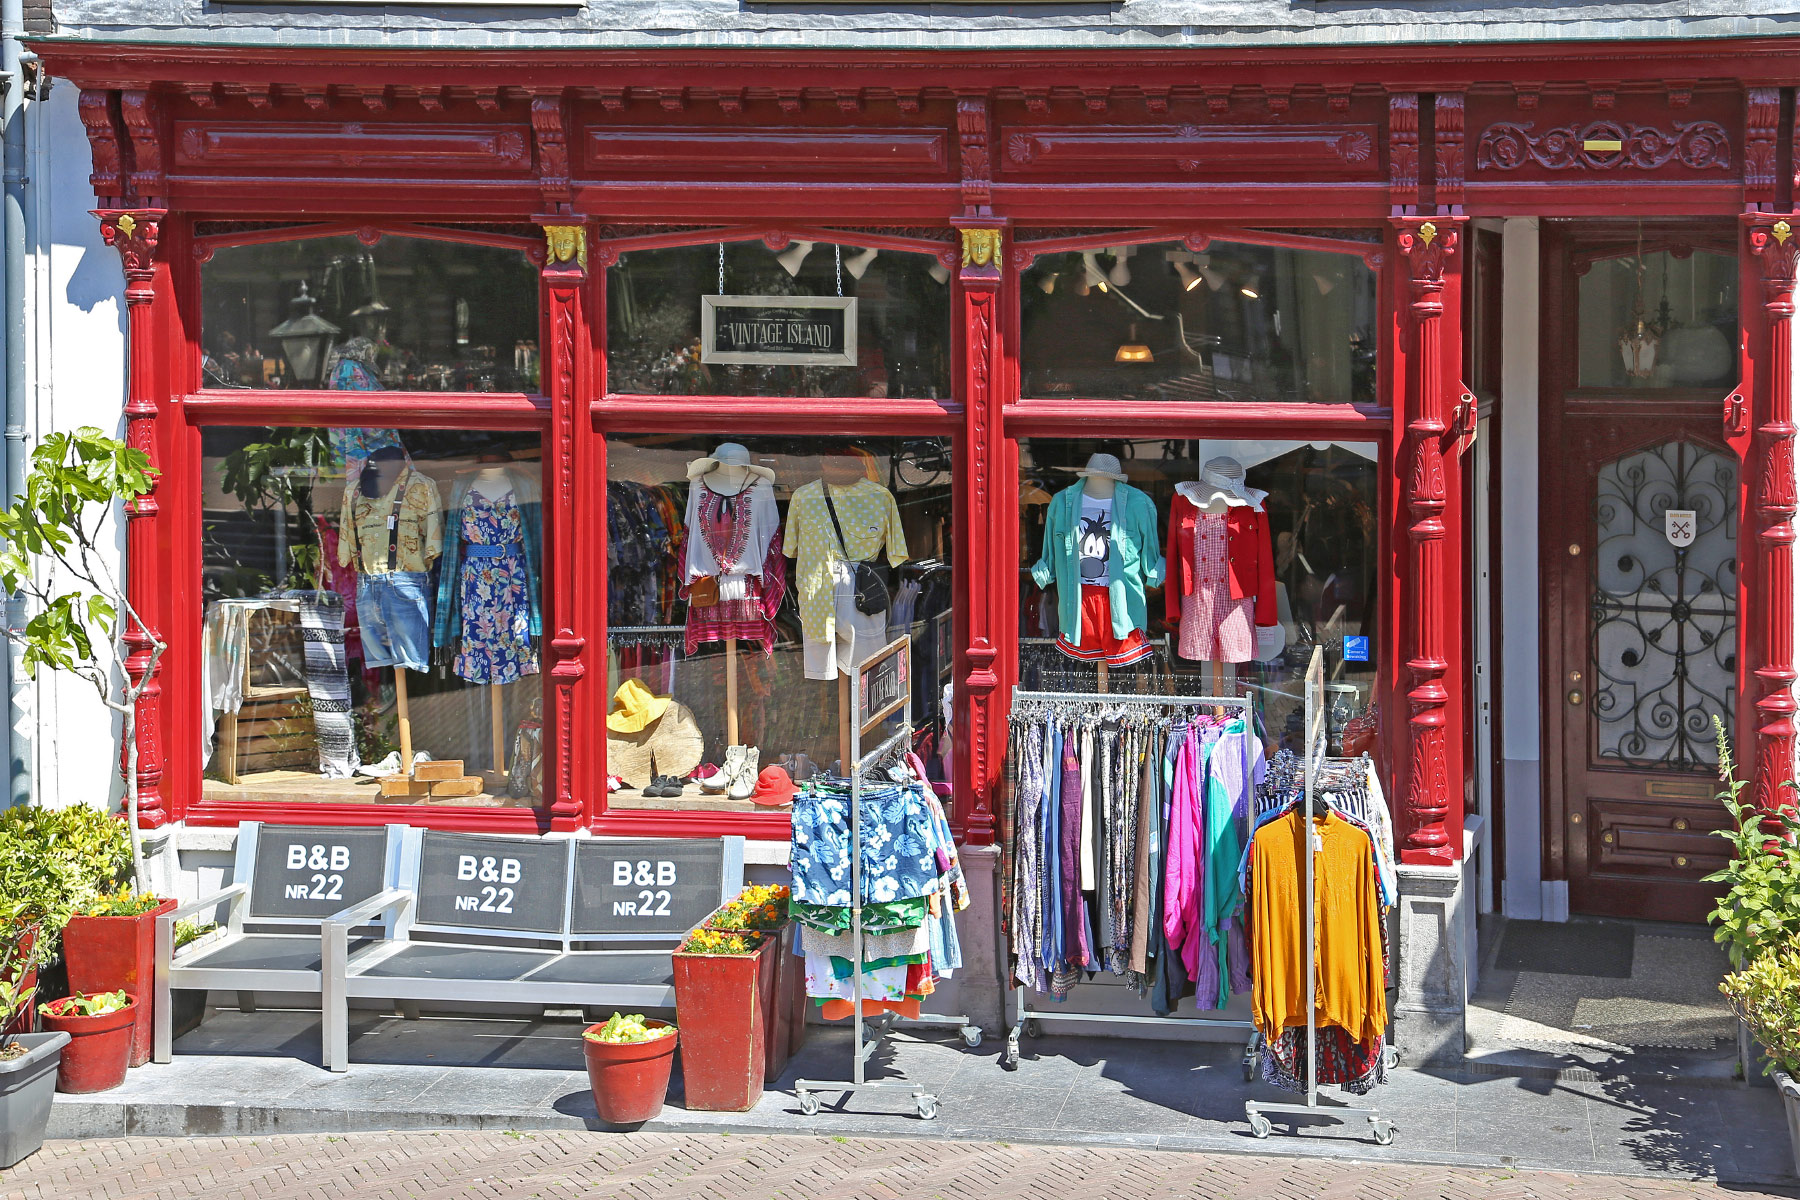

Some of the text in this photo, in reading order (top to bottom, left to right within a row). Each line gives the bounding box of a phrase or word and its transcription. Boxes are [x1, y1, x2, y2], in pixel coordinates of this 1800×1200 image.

[730, 322, 832, 348] VINTAGE ISLAND
[286, 844, 350, 871] B&B
[457, 855, 521, 884] B&B
[612, 860, 677, 887] B&B
